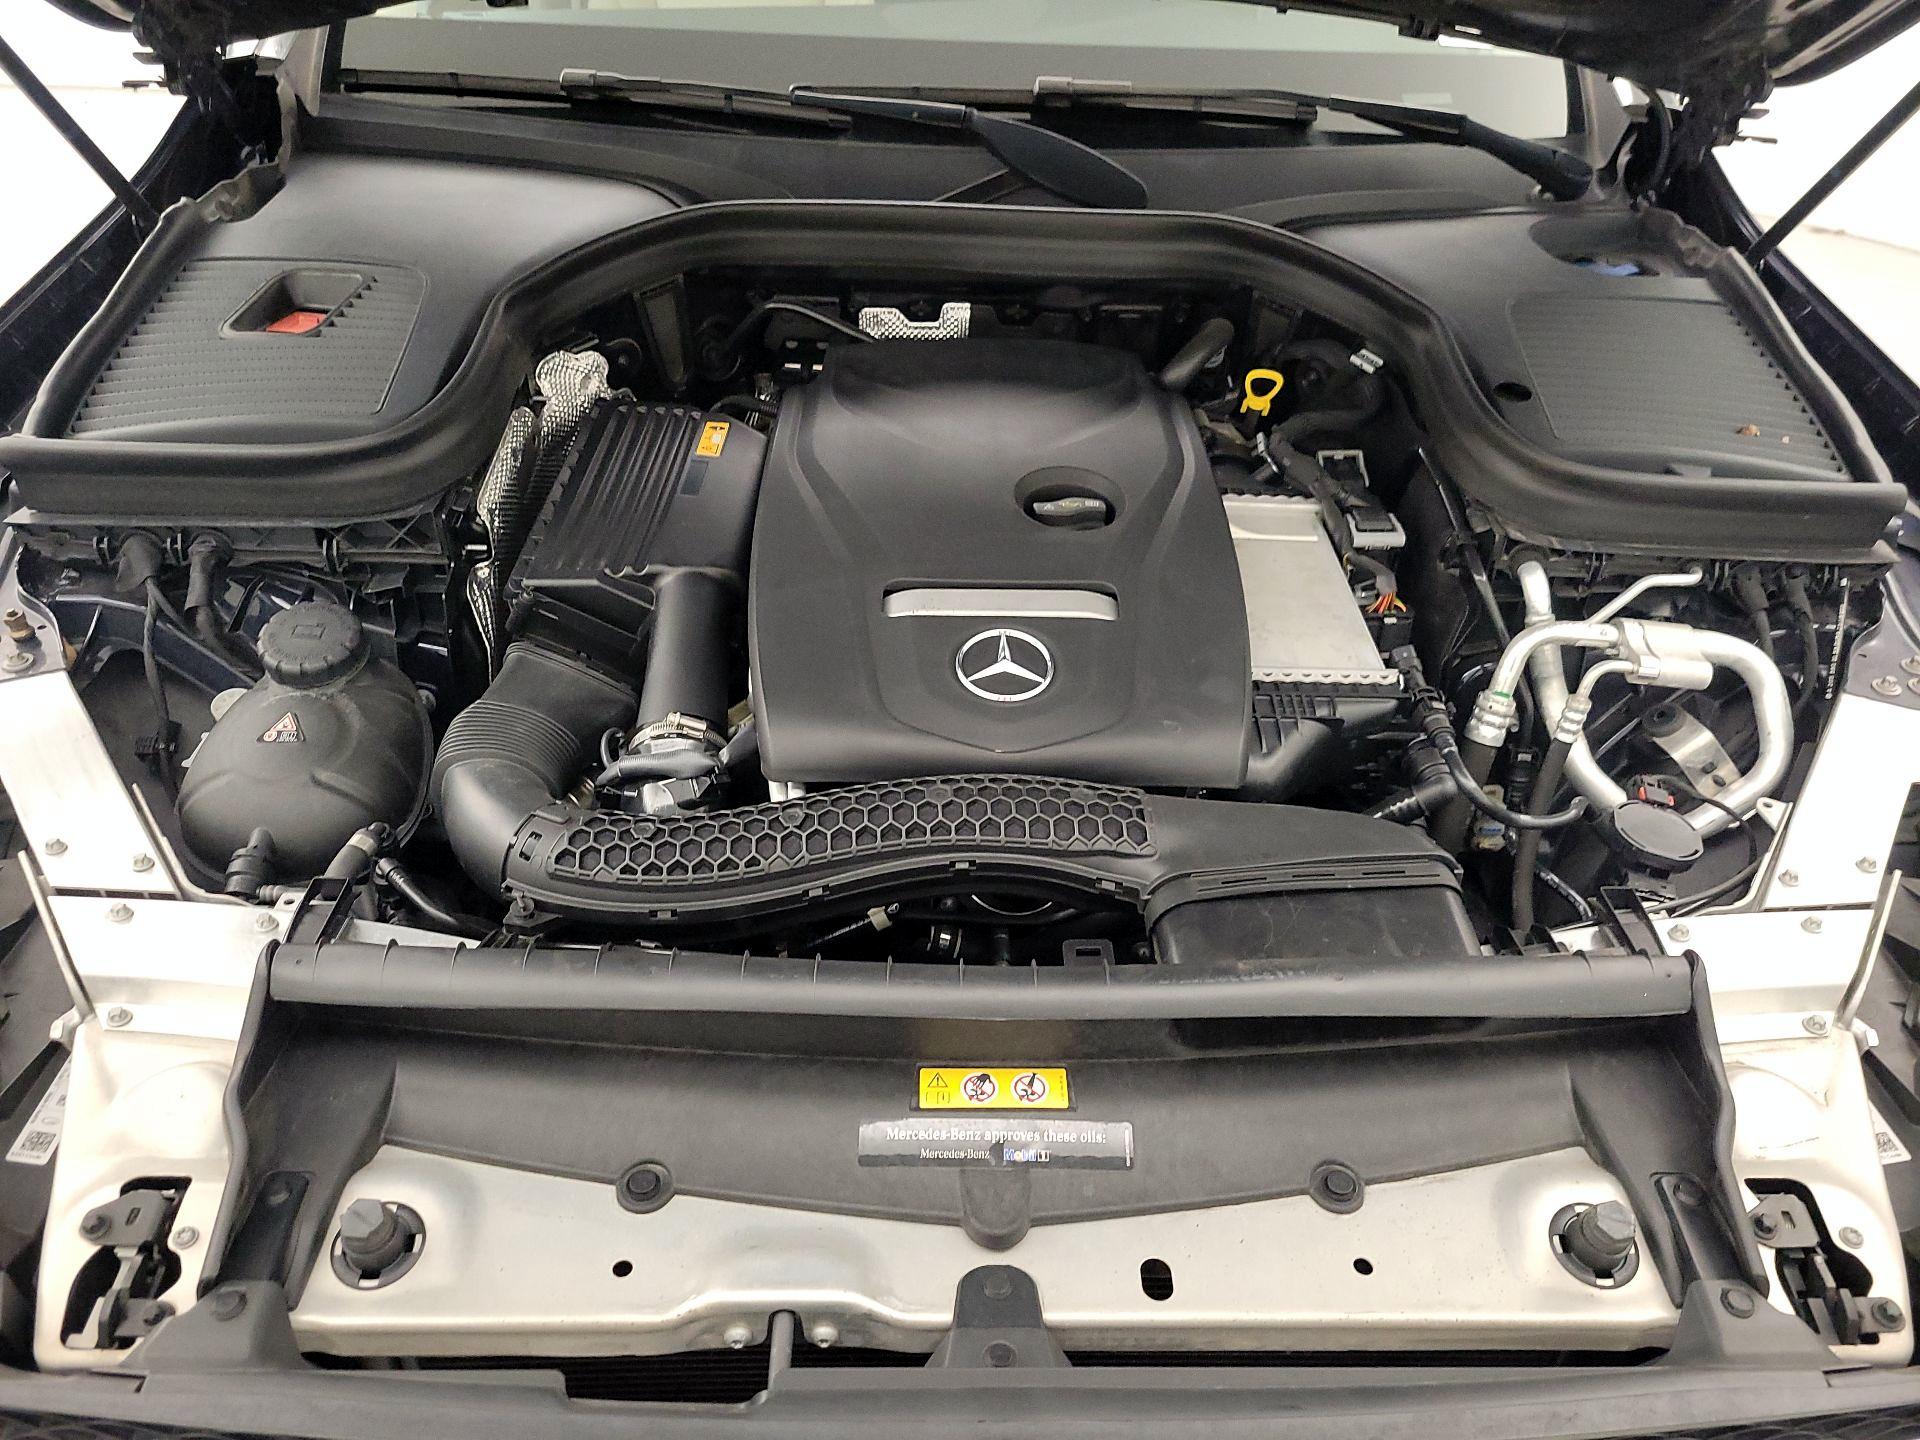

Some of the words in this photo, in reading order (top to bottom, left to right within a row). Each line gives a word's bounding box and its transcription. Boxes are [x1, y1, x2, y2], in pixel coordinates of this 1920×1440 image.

[886, 1126, 982, 1141] Mercedes-Benz
[984, 1129, 1041, 1145] approves
[1044, 1128, 1077, 1143] these
[1080, 1130, 1107, 1144] oils:
[920, 1147, 990, 1160] Mercedes-Benz
